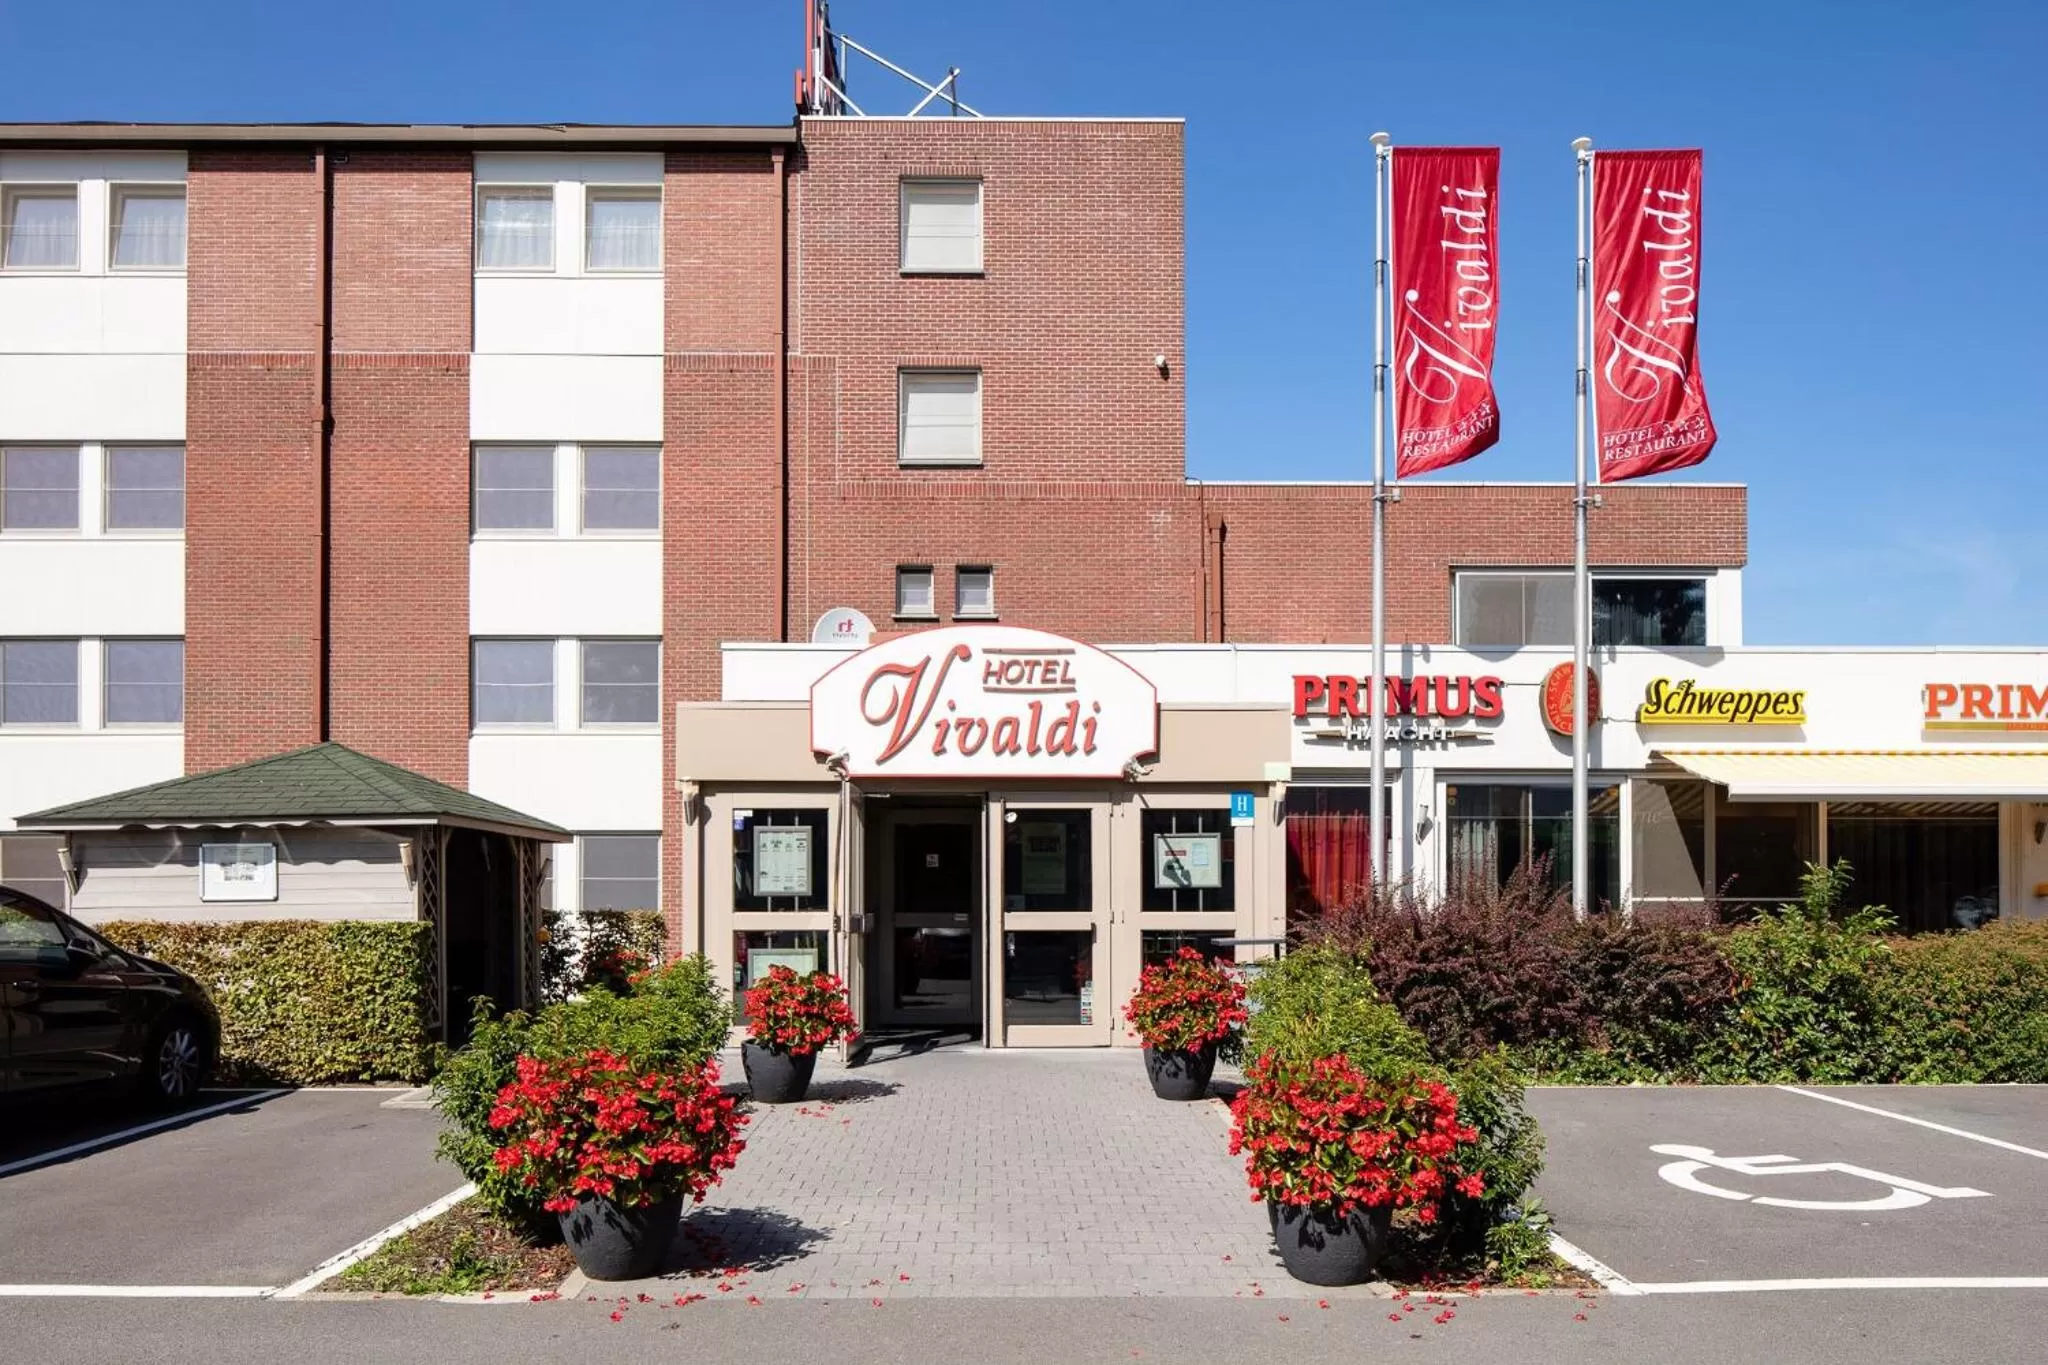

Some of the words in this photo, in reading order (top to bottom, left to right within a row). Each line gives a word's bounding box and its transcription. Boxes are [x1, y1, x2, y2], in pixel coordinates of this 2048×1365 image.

[1403, 427, 1451, 444] HOTEL
[1404, 415, 1495, 457] RESTAURANT
[1603, 428, 1655, 447] HOTEL
[1604, 427, 1707, 461] RESTAURANT
[982, 659, 1076, 685] HOTEL
[860, 644, 1102, 766] Vivaldi
[1644, 679, 1804, 722] Schweppes
